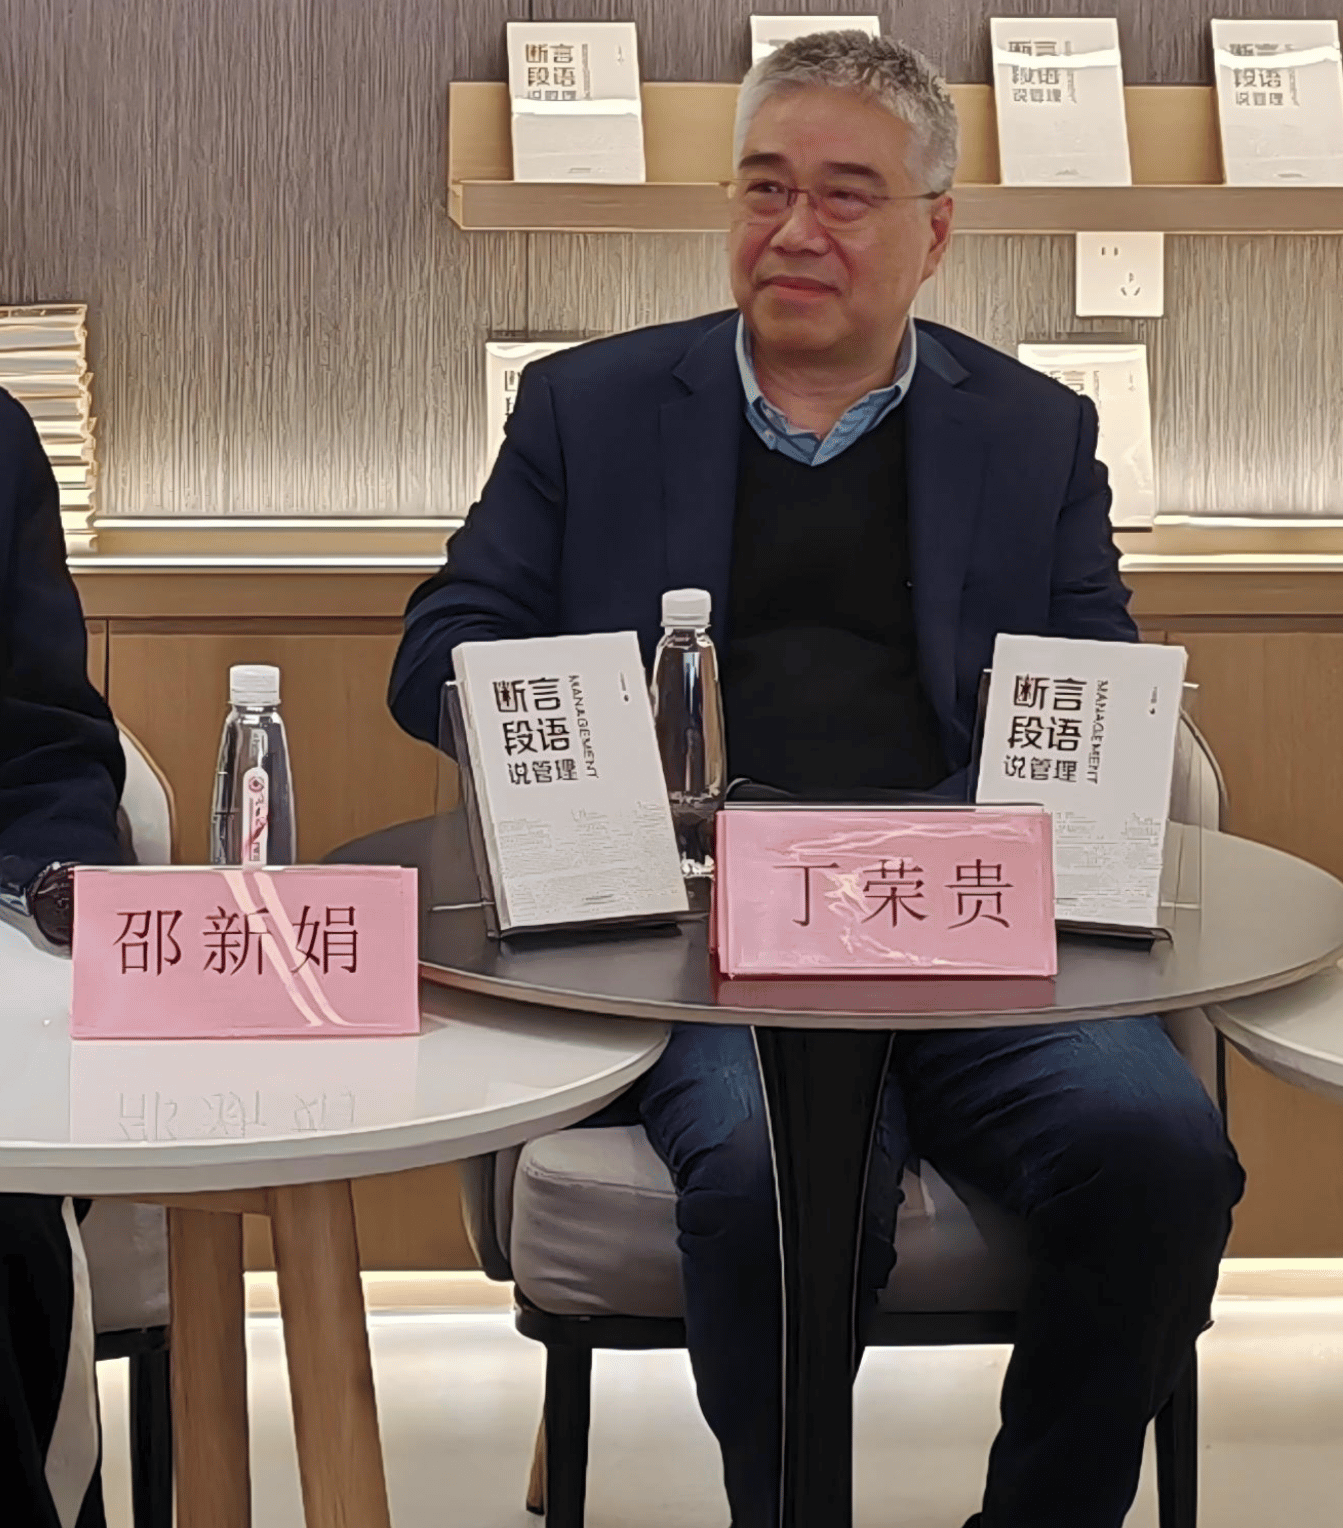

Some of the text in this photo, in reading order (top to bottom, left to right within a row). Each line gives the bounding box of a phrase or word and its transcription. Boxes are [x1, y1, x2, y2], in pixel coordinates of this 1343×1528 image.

[492, 677, 561, 713] 断言
[1013, 674, 1087, 711] 断言
[503, 717, 570, 756] 段语
[1007, 716, 1083, 752] 段语
[508, 758, 579, 785] 说管理
[1003, 755, 1078, 783] 说管理
[772, 858, 1015, 930] 丁荣贵
[112, 905, 359, 976] 邵新娟
